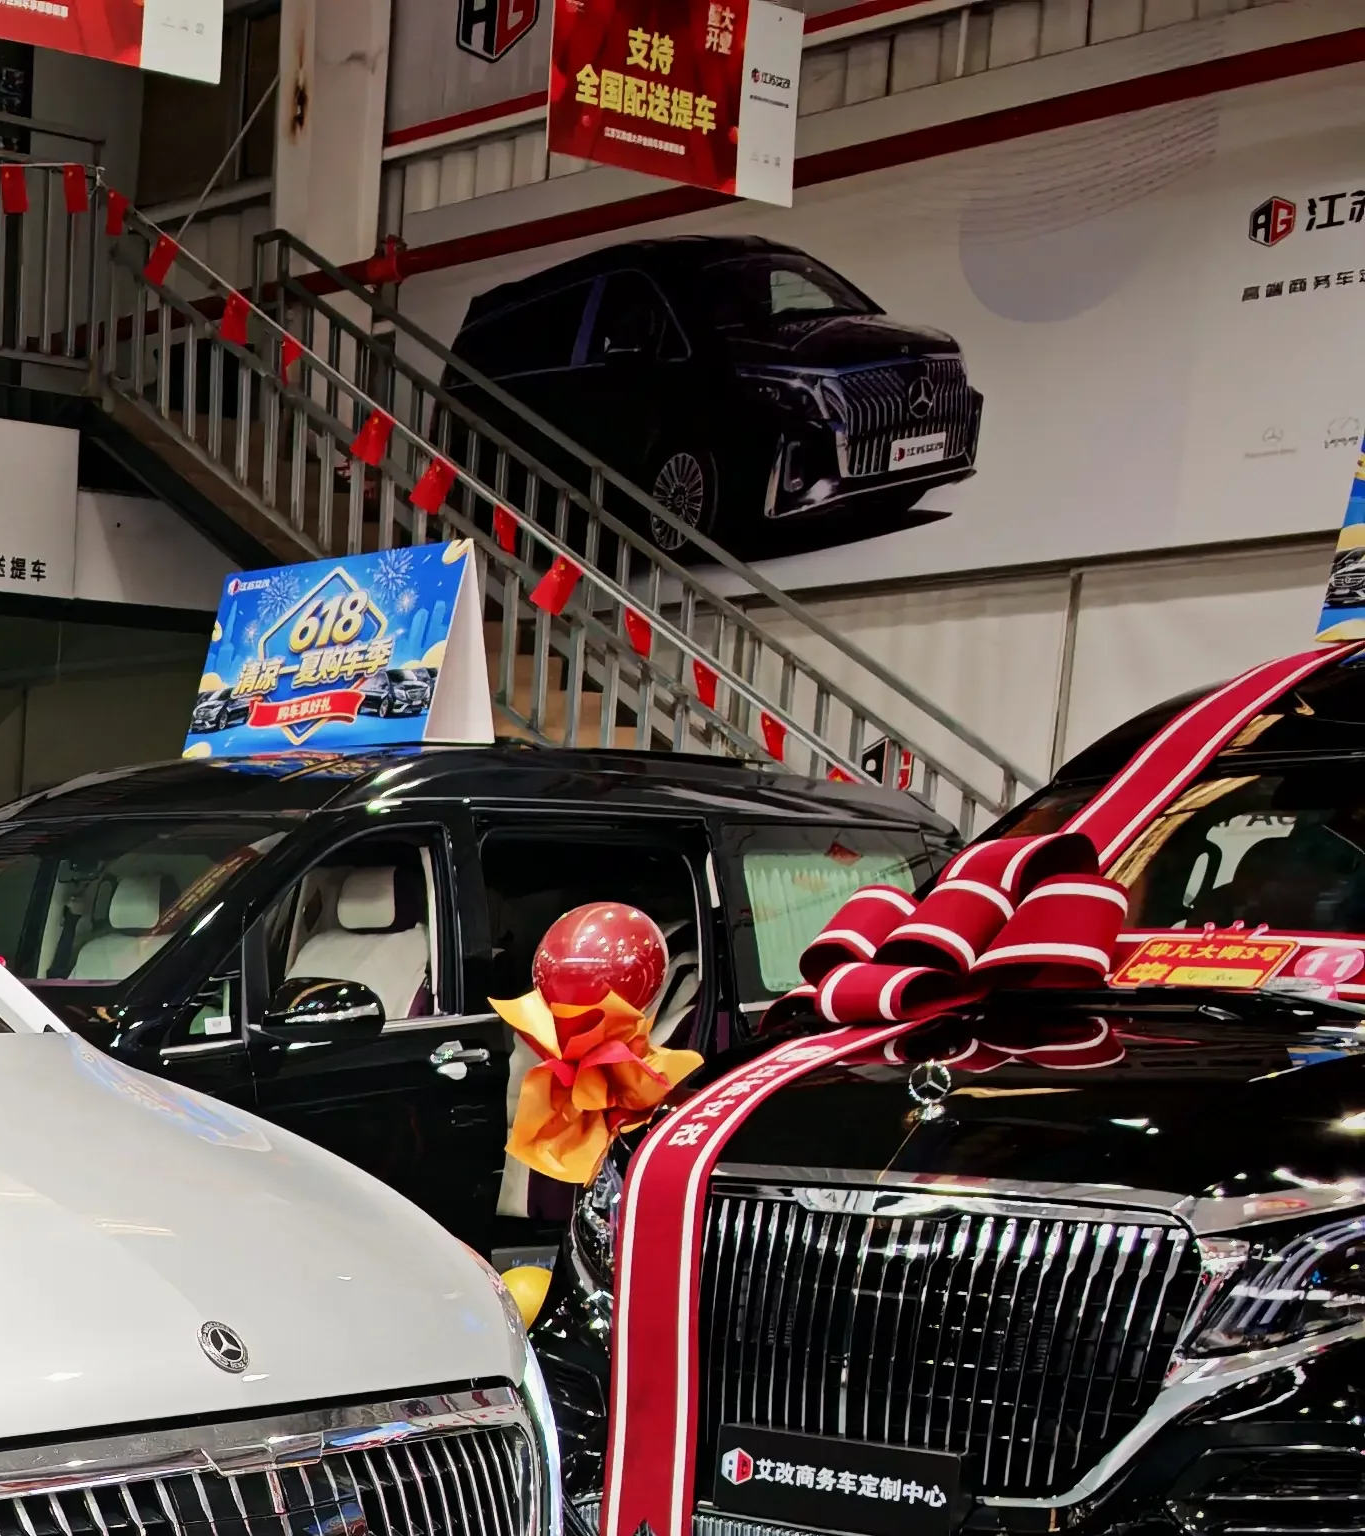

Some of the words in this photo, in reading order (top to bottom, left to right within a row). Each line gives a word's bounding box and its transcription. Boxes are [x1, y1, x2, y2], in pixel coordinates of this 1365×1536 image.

[626, 27, 675, 75] 支持
[575, 63, 717, 135] 全国配送提车
[1248, 195, 1297, 247] AG
[289, 590, 368, 653] 618
[231, 636, 393, 699] 清凉一夏购车季
[1145, 942, 1282, 963] 非凡大师3号
[1304, 950, 1352, 979] 11
[755, 1458, 947, 1508] 艾改商务车定制中心
